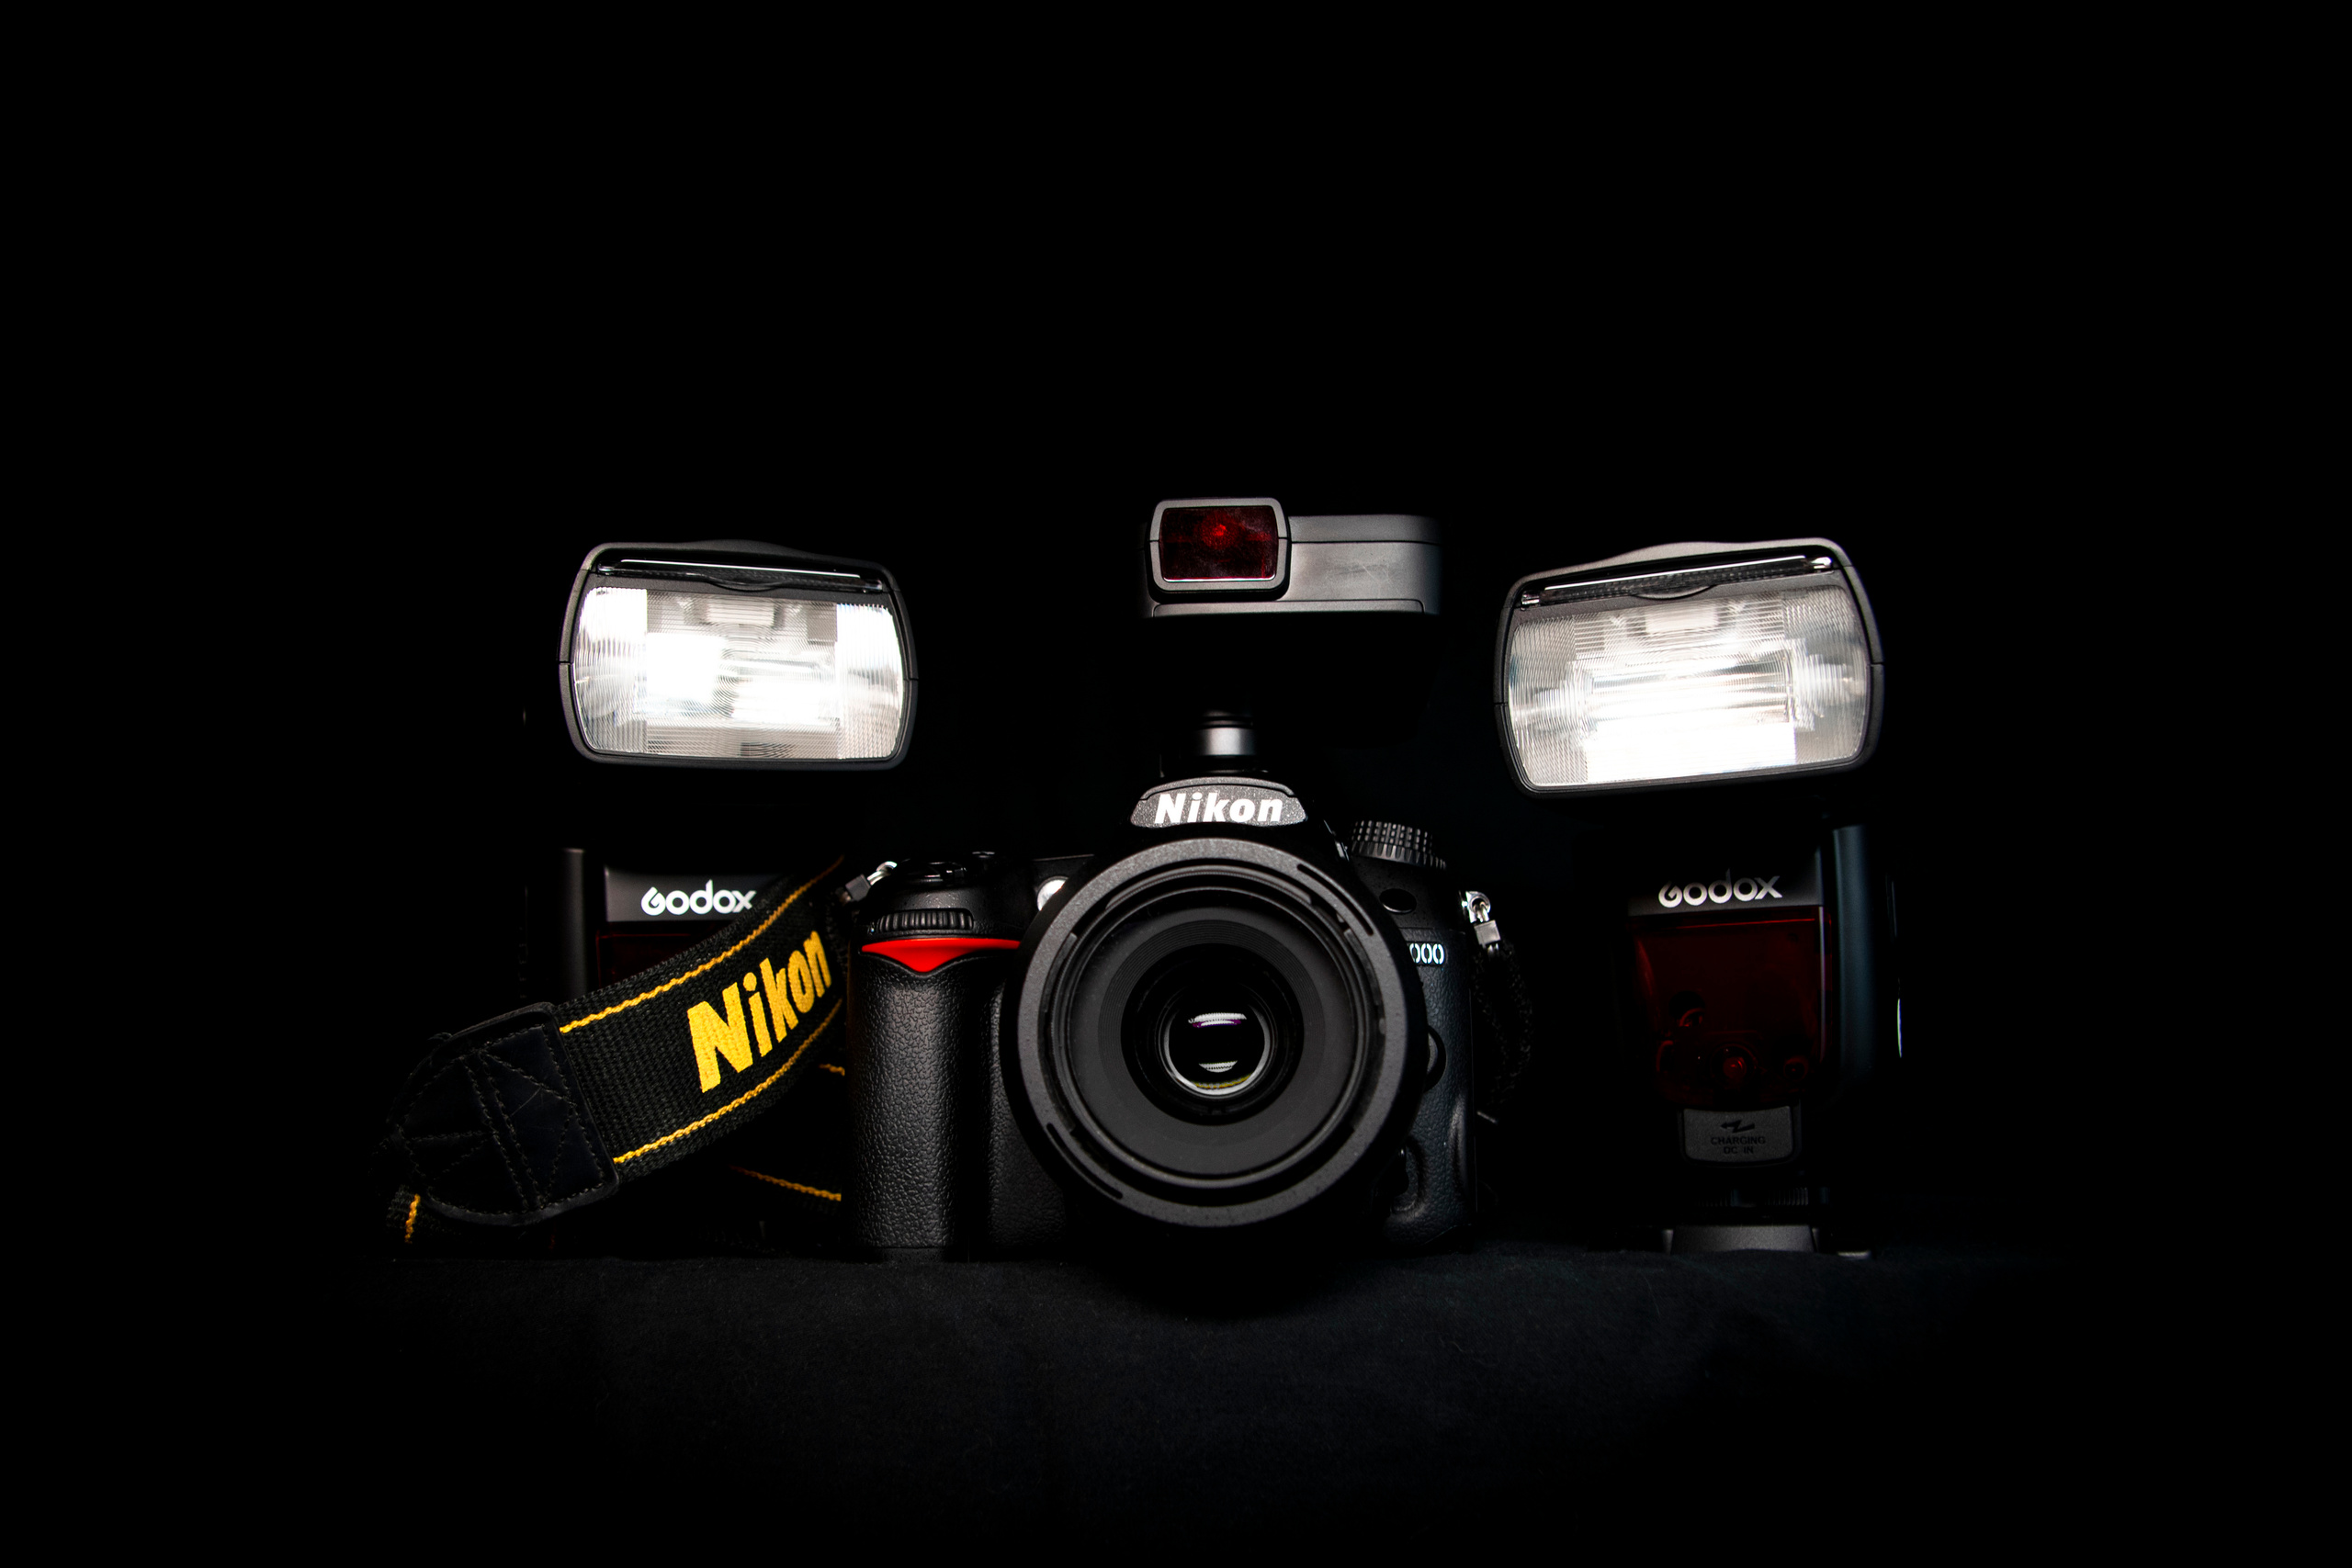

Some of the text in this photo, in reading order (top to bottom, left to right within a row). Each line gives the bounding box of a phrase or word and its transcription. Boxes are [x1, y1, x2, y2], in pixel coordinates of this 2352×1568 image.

[1154, 792, 1283, 824] Nikon
[641, 879, 757, 916] Godox
[1658, 868, 1782, 908] Godox
[1408, 942, 1445, 964] 000
[686, 931, 831, 1093] Nikon
[1710, 1136, 1766, 1145] CHARGING
[1724, 1146, 1754, 1155] DC IN
